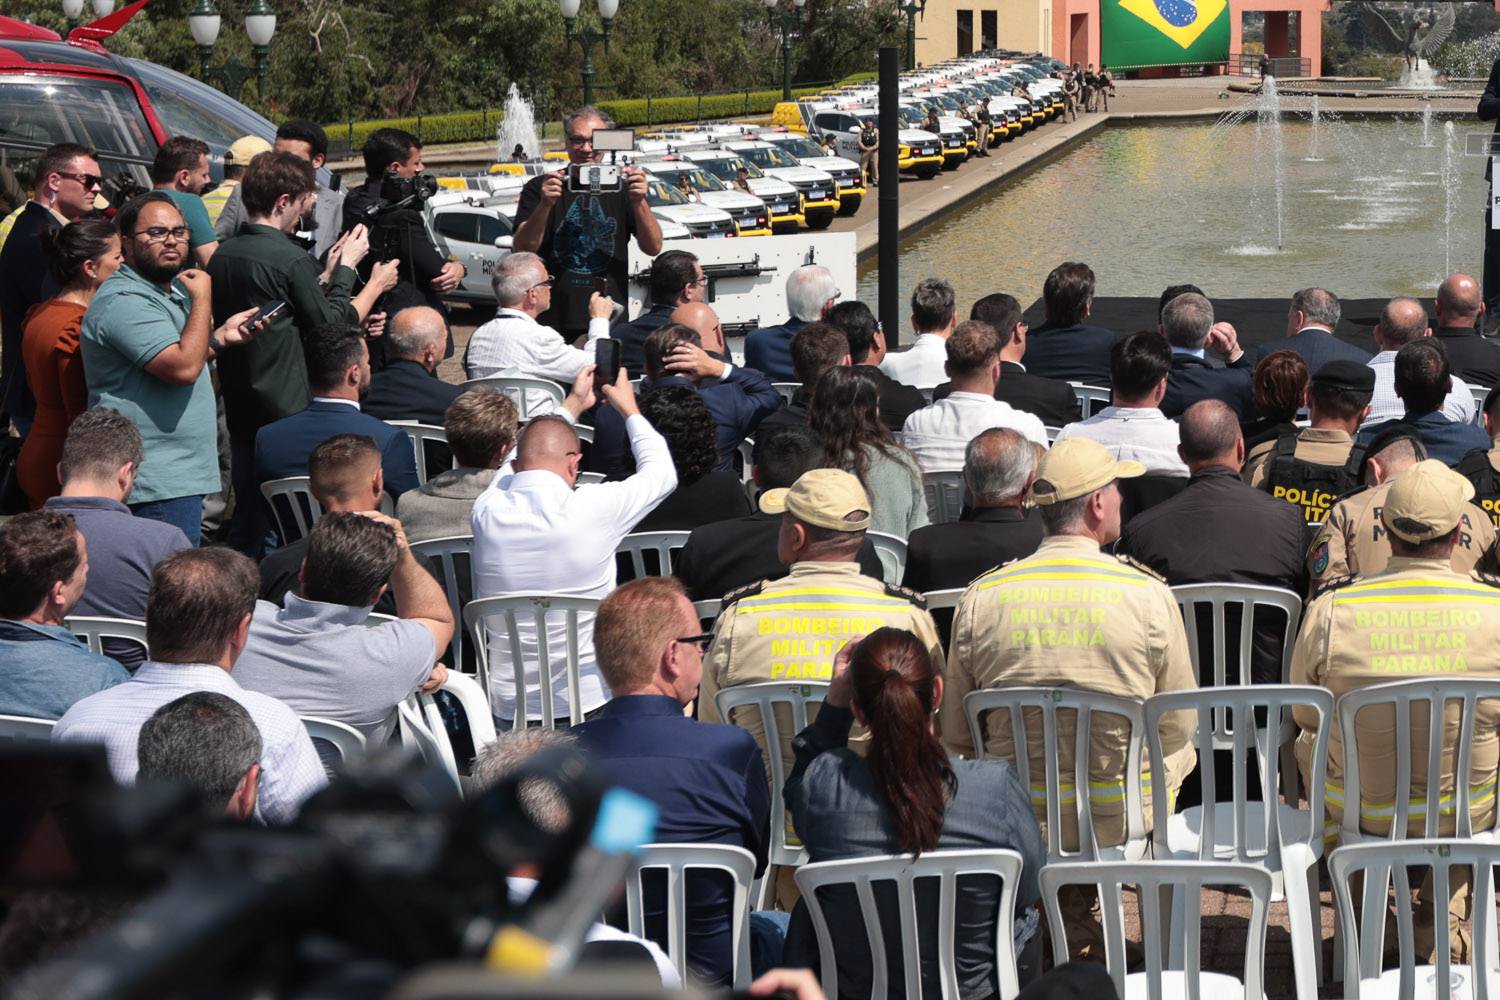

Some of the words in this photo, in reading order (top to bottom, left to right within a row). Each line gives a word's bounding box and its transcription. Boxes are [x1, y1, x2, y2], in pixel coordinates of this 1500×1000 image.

[1274, 485, 1336, 508] POLÍC
[998, 587, 1123, 605] BOMBEIRO
[1011, 607, 1106, 625] MILITAR
[1356, 609, 1482, 627] BOMBEIRO
[758, 617, 884, 635] BOMBEIRO
[1011, 626, 1106, 647] PARANÁ
[1370, 631, 1468, 650] MILITAR
[771, 640, 848, 657] MILIT
[771, 662, 832, 679] PARA
[1371, 651, 1468, 673] PARANÁ
